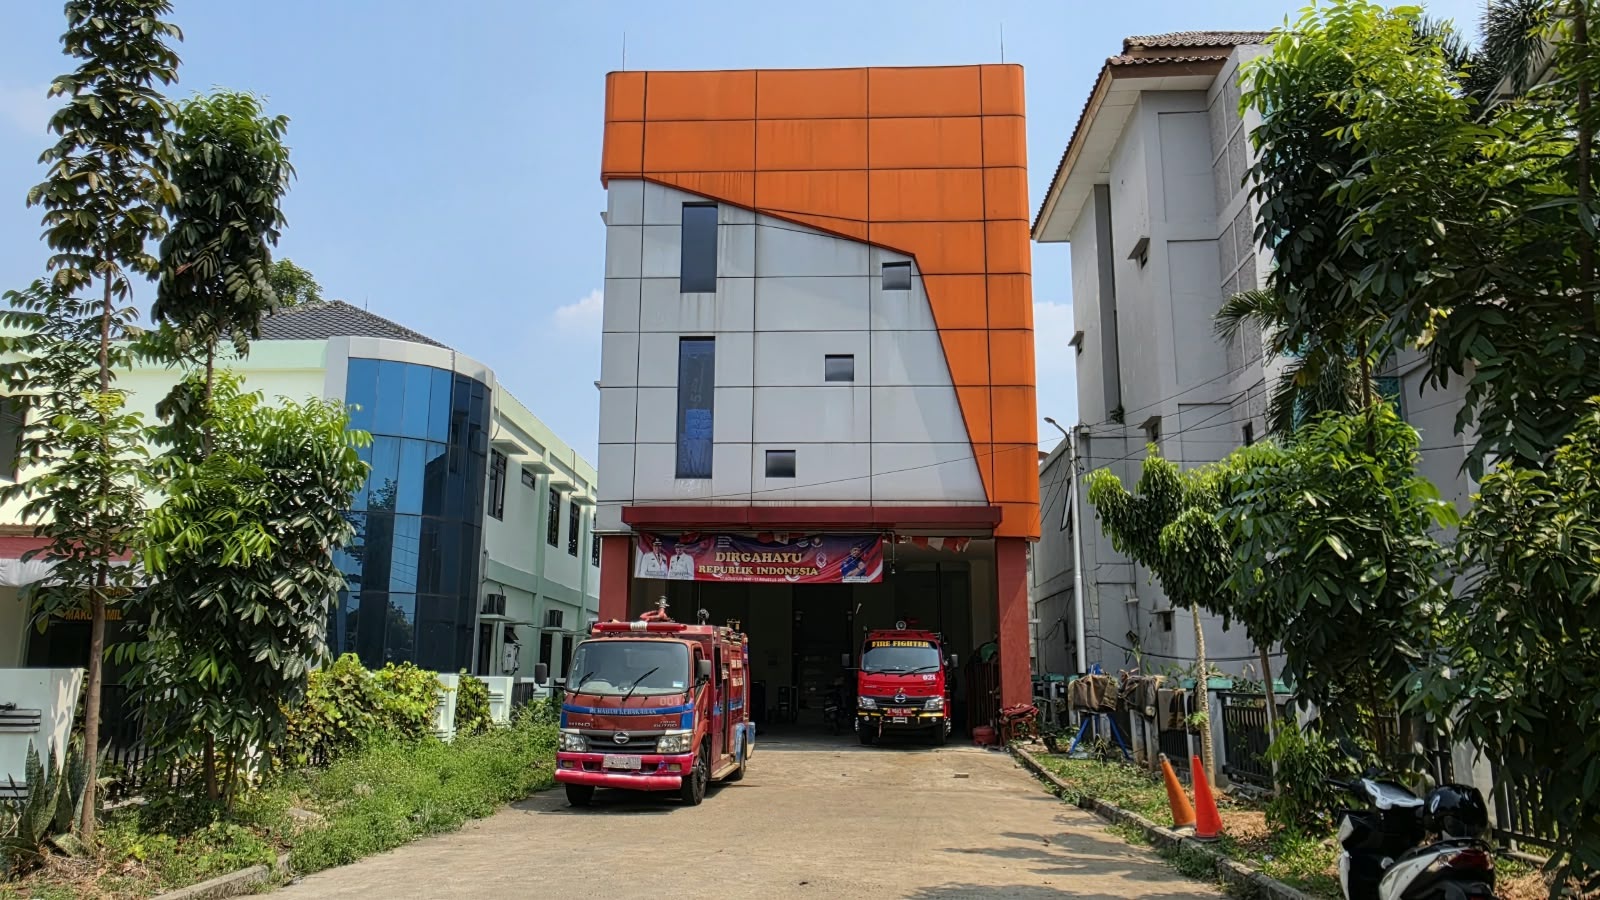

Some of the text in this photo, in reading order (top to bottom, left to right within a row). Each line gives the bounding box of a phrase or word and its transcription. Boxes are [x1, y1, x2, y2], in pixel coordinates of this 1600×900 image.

[715, 552, 802, 563] DIRGAHAYU
[698, 565, 753, 575] REPUBLIK
[756, 567, 818, 576] INDONESIA
